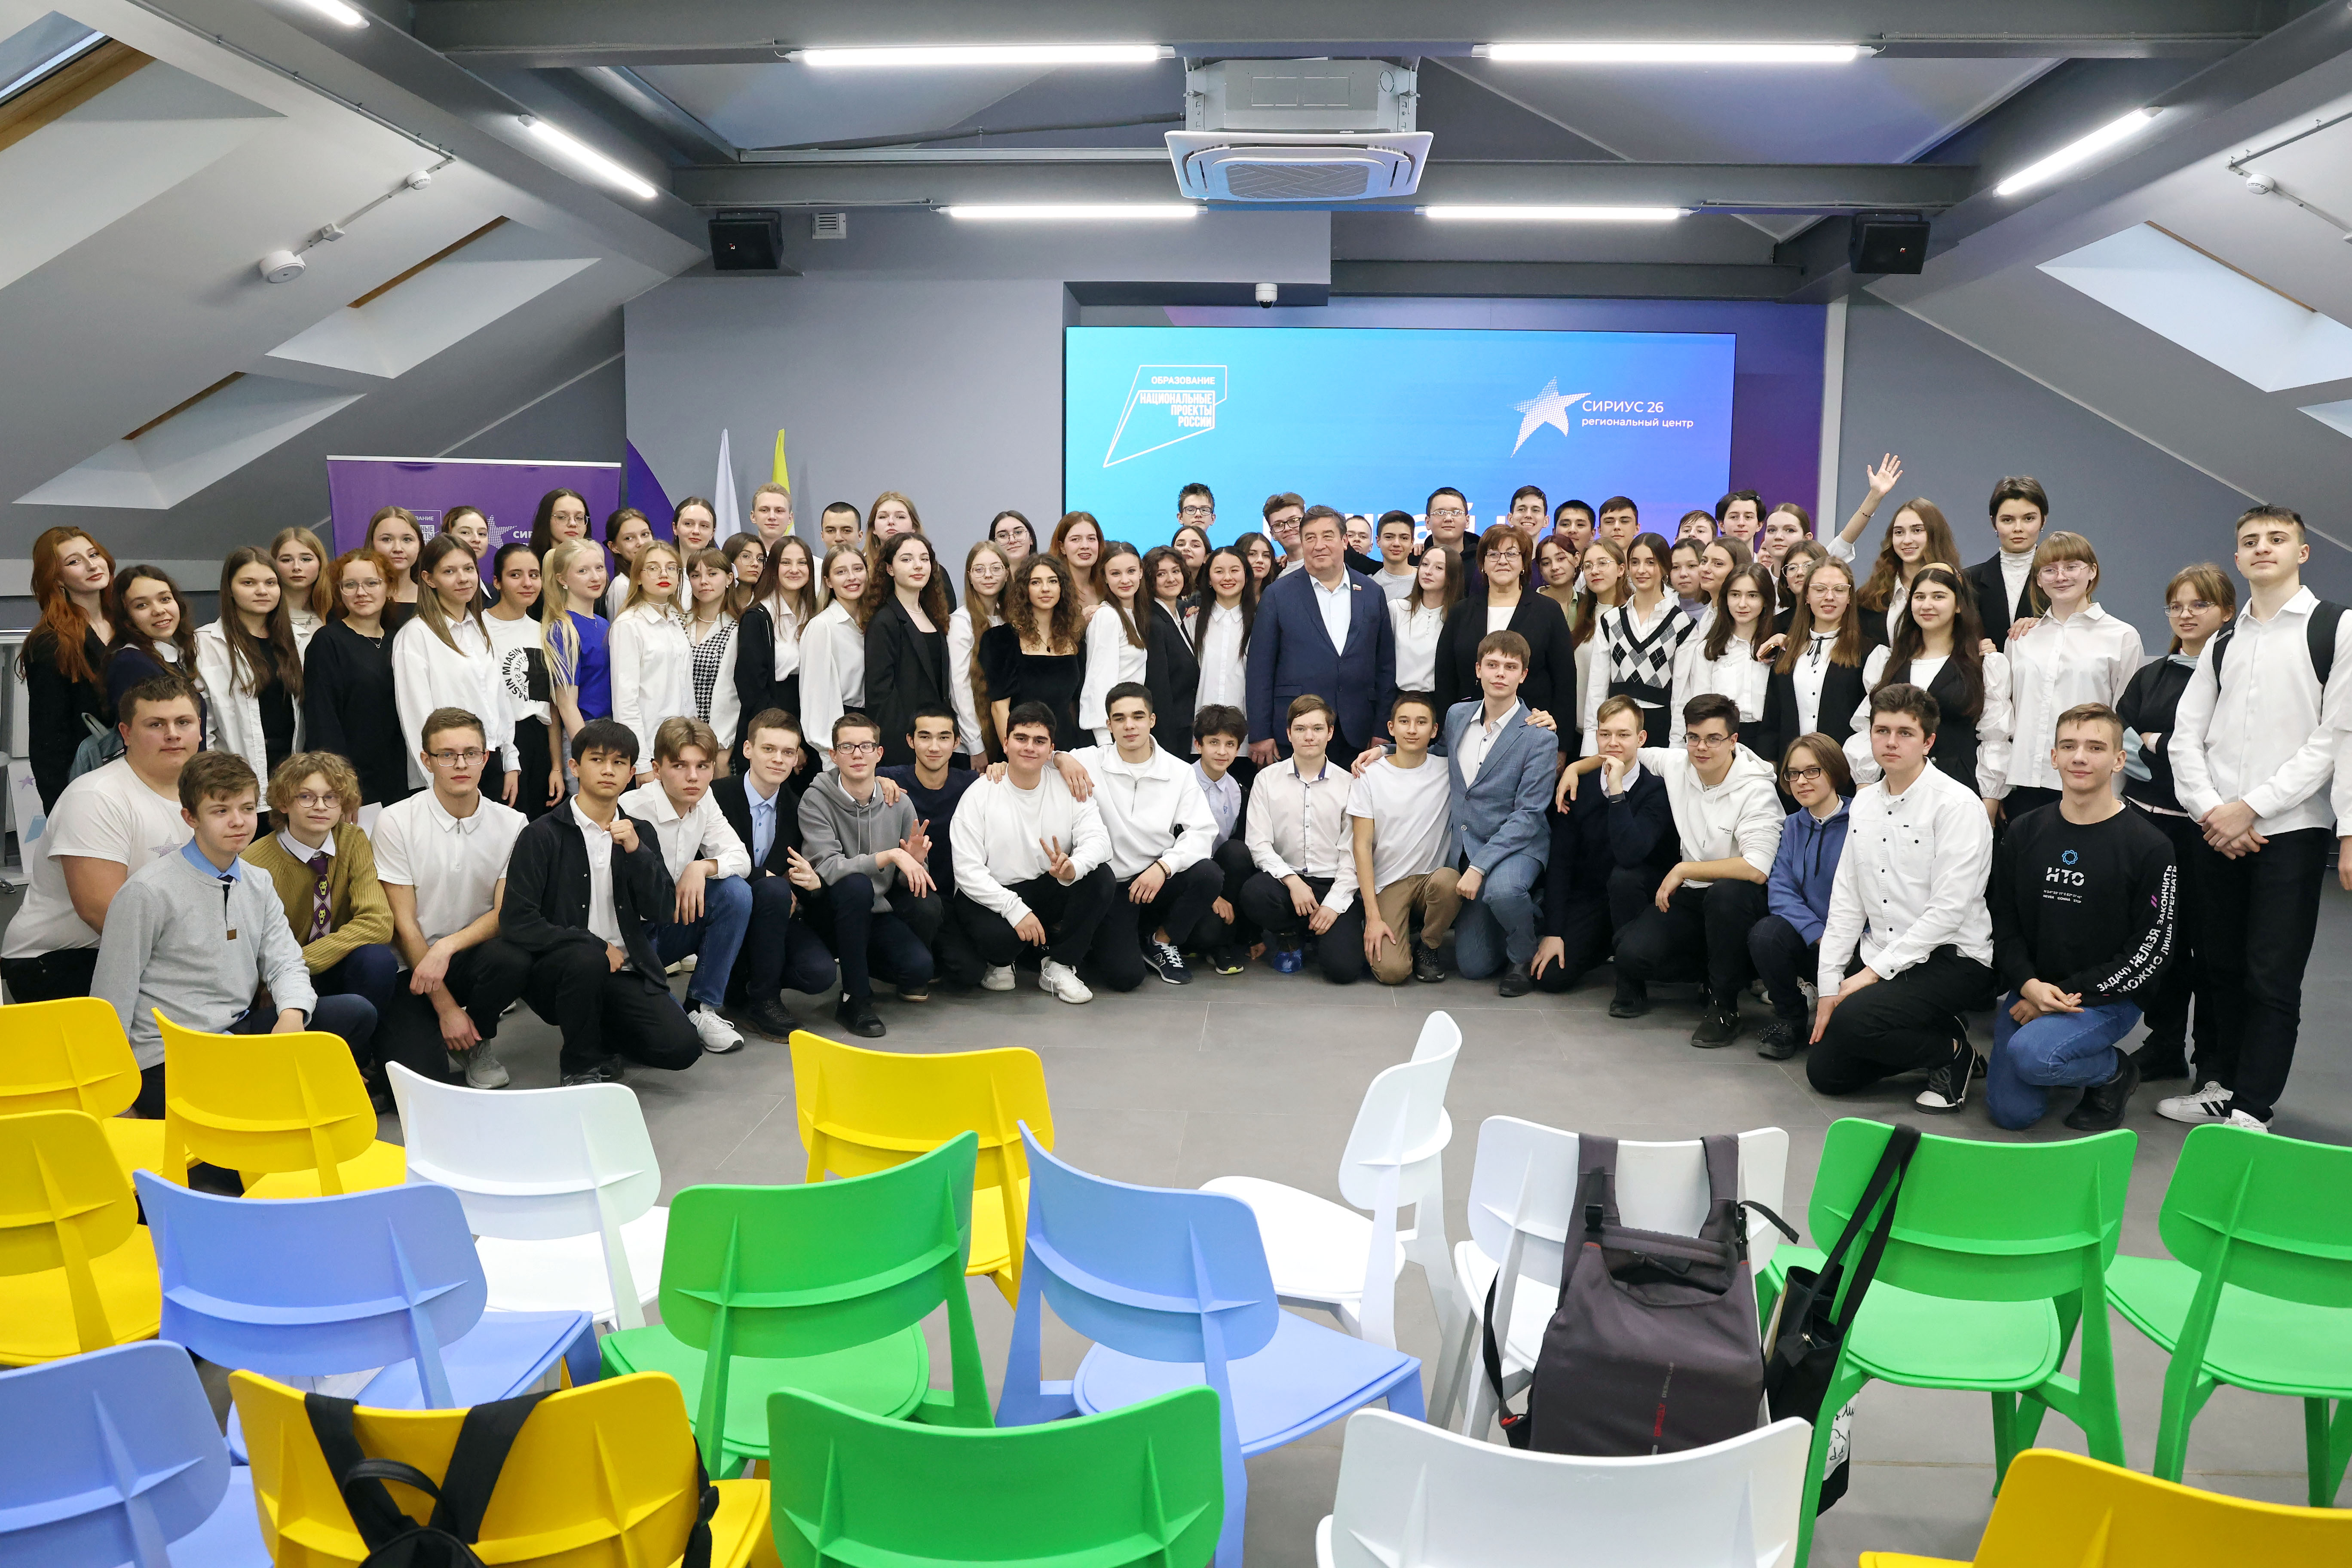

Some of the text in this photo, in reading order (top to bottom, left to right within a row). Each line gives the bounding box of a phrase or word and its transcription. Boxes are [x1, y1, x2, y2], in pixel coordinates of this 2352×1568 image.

[1151, 376, 1216, 384] ОБРАЗОВАНИЕ
[1140, 393, 1212, 405] НАЦИОНАЛЬНЫЕ
[1171, 404, 1212, 416] ПРОЕКТЫ
[1582, 400, 1664, 413] СИРИУС 26
[1178, 416, 1212, 427] РОССИИ
[1582, 418, 1694, 429] региональный центр
[2097, 865, 2172, 992] ЗАДАЧУ НЕЛЬЗЯ ЗАКОНЧИТЬ
[2117, 866, 2177, 993] МОЖНО ЛИШЬ ПРЕРВАТЬ
